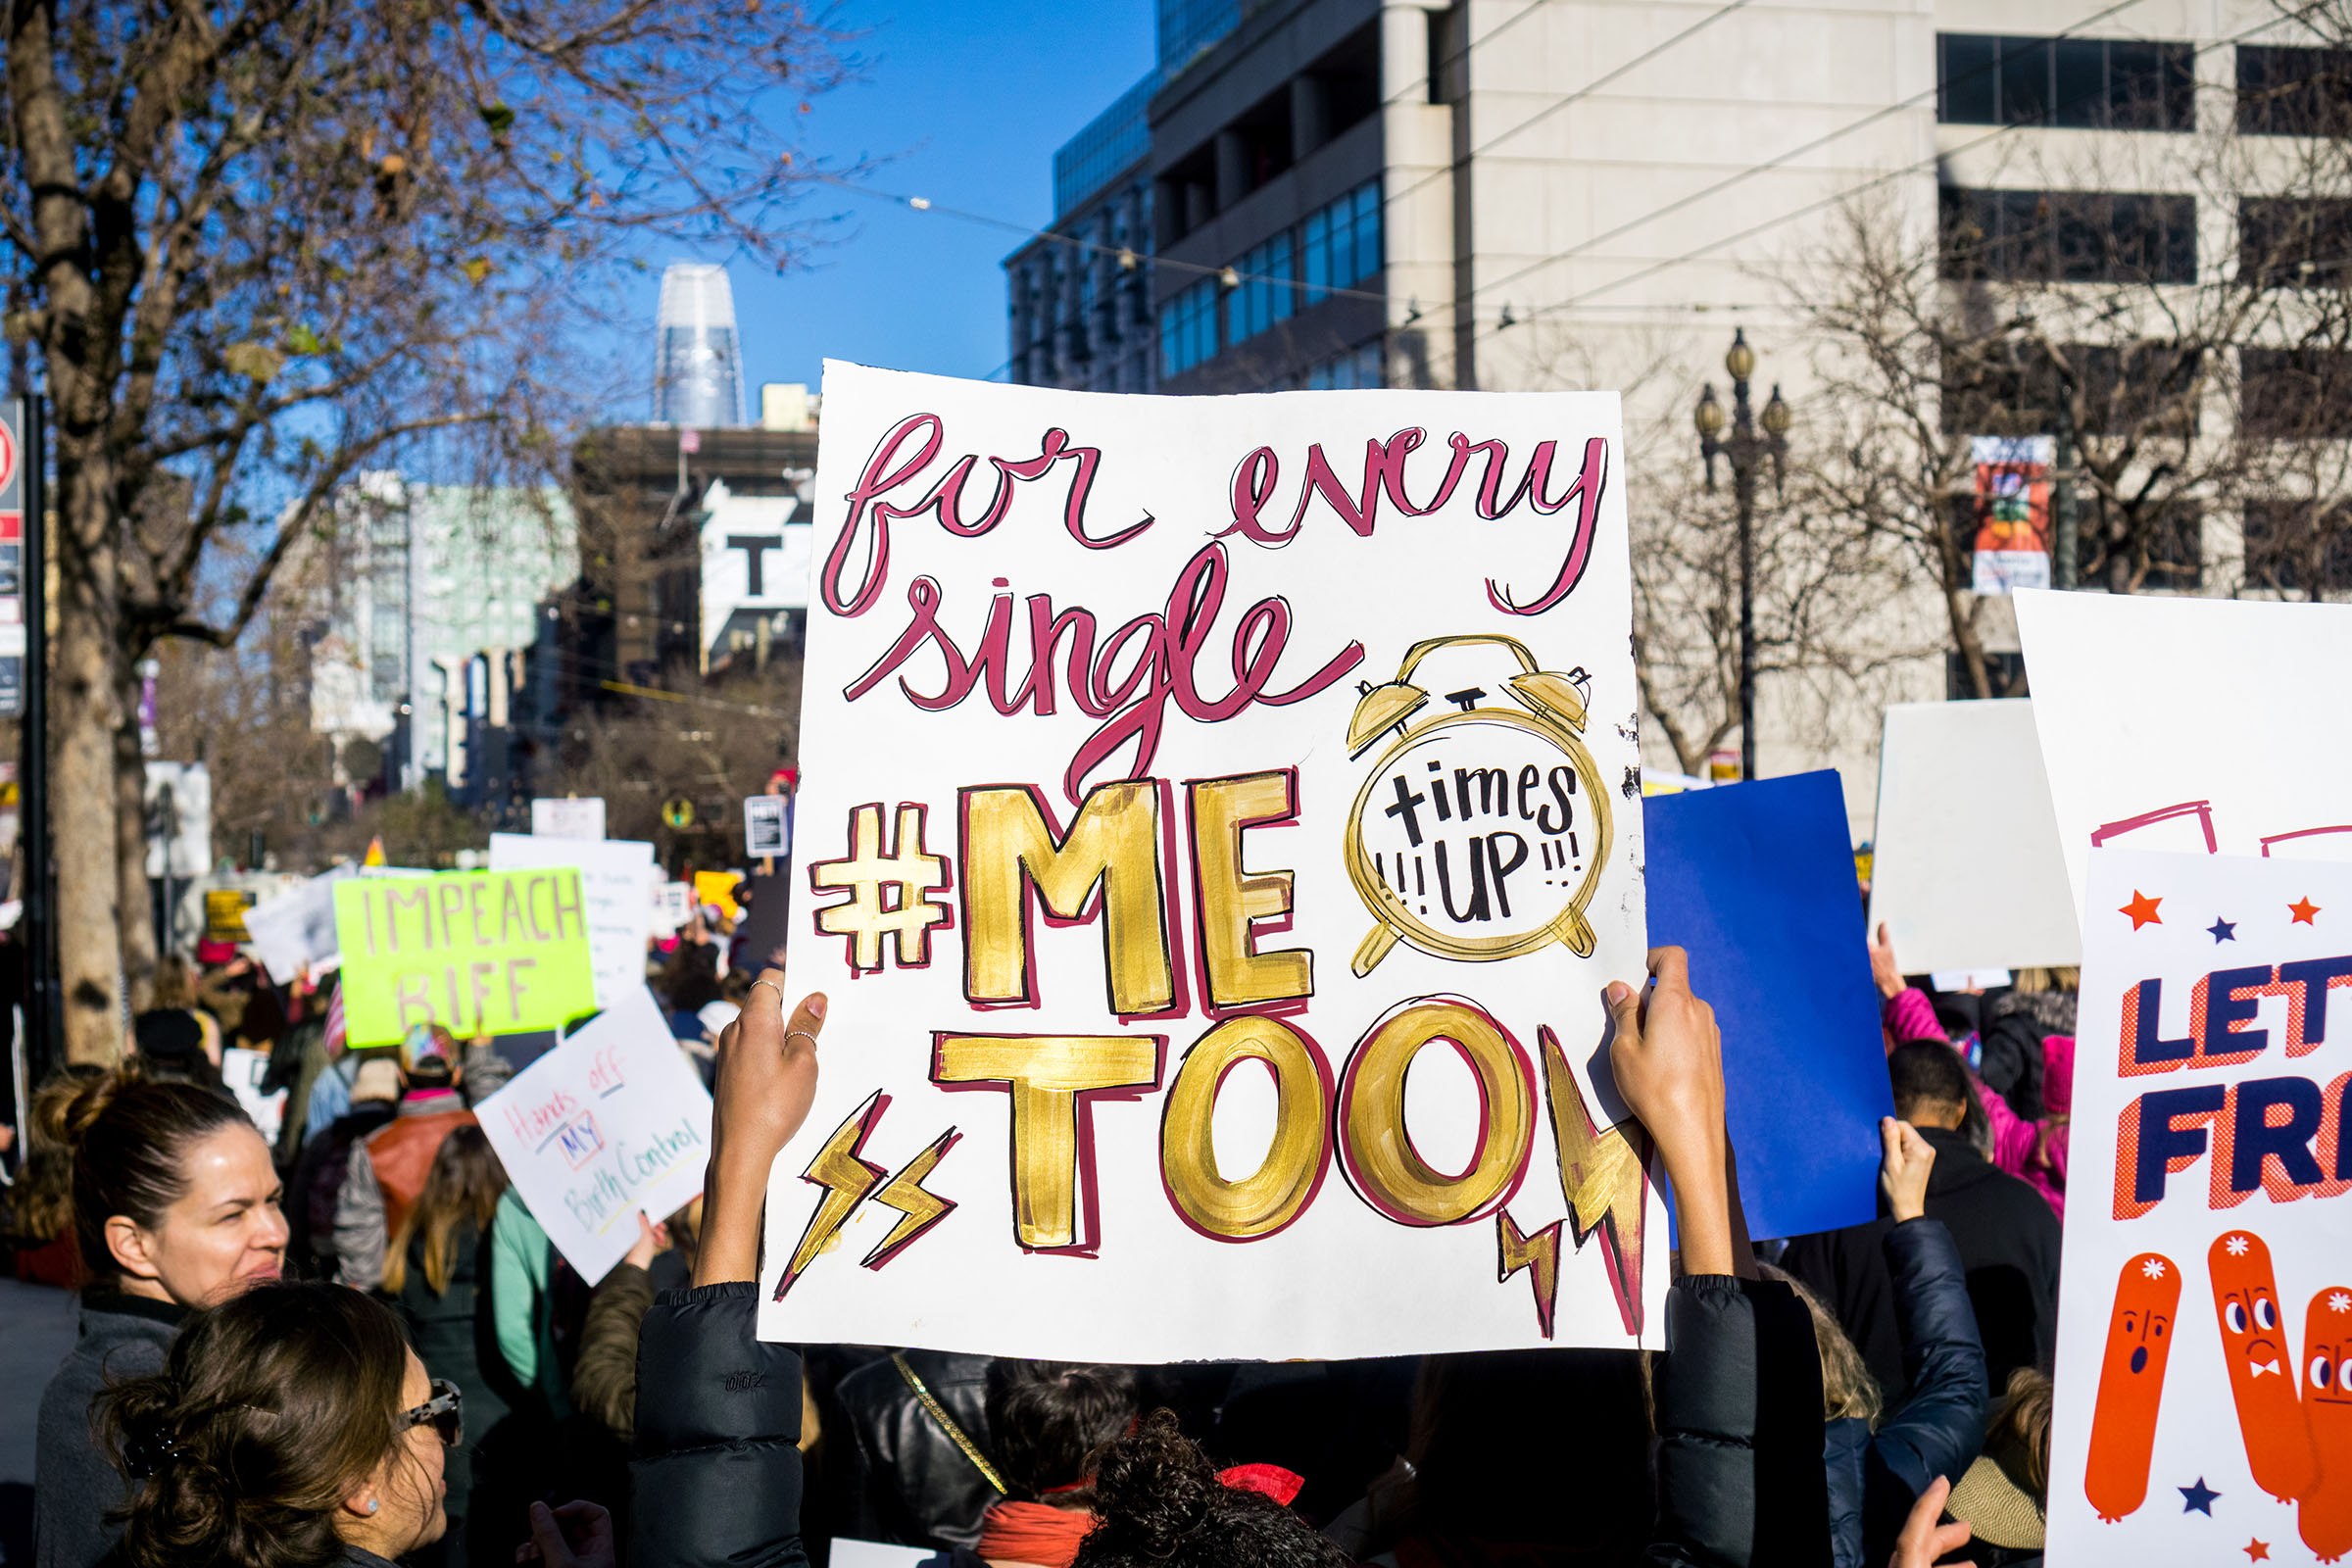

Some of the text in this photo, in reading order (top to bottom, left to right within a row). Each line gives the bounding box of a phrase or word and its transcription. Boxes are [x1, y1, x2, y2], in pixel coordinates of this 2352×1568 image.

[820, 413, 1607, 617] for every
[843, 539, 1364, 808] single
[1385, 760, 1577, 847] times
[362, 873, 585, 956] IMPEACH
[397, 957, 537, 1031] BIFF
[561, 1118, 605, 1161] MY
[615, 1116, 702, 1186] Control
[928, 992, 1540, 1258] TOO
[2112, 1070, 2352, 1221] FR
